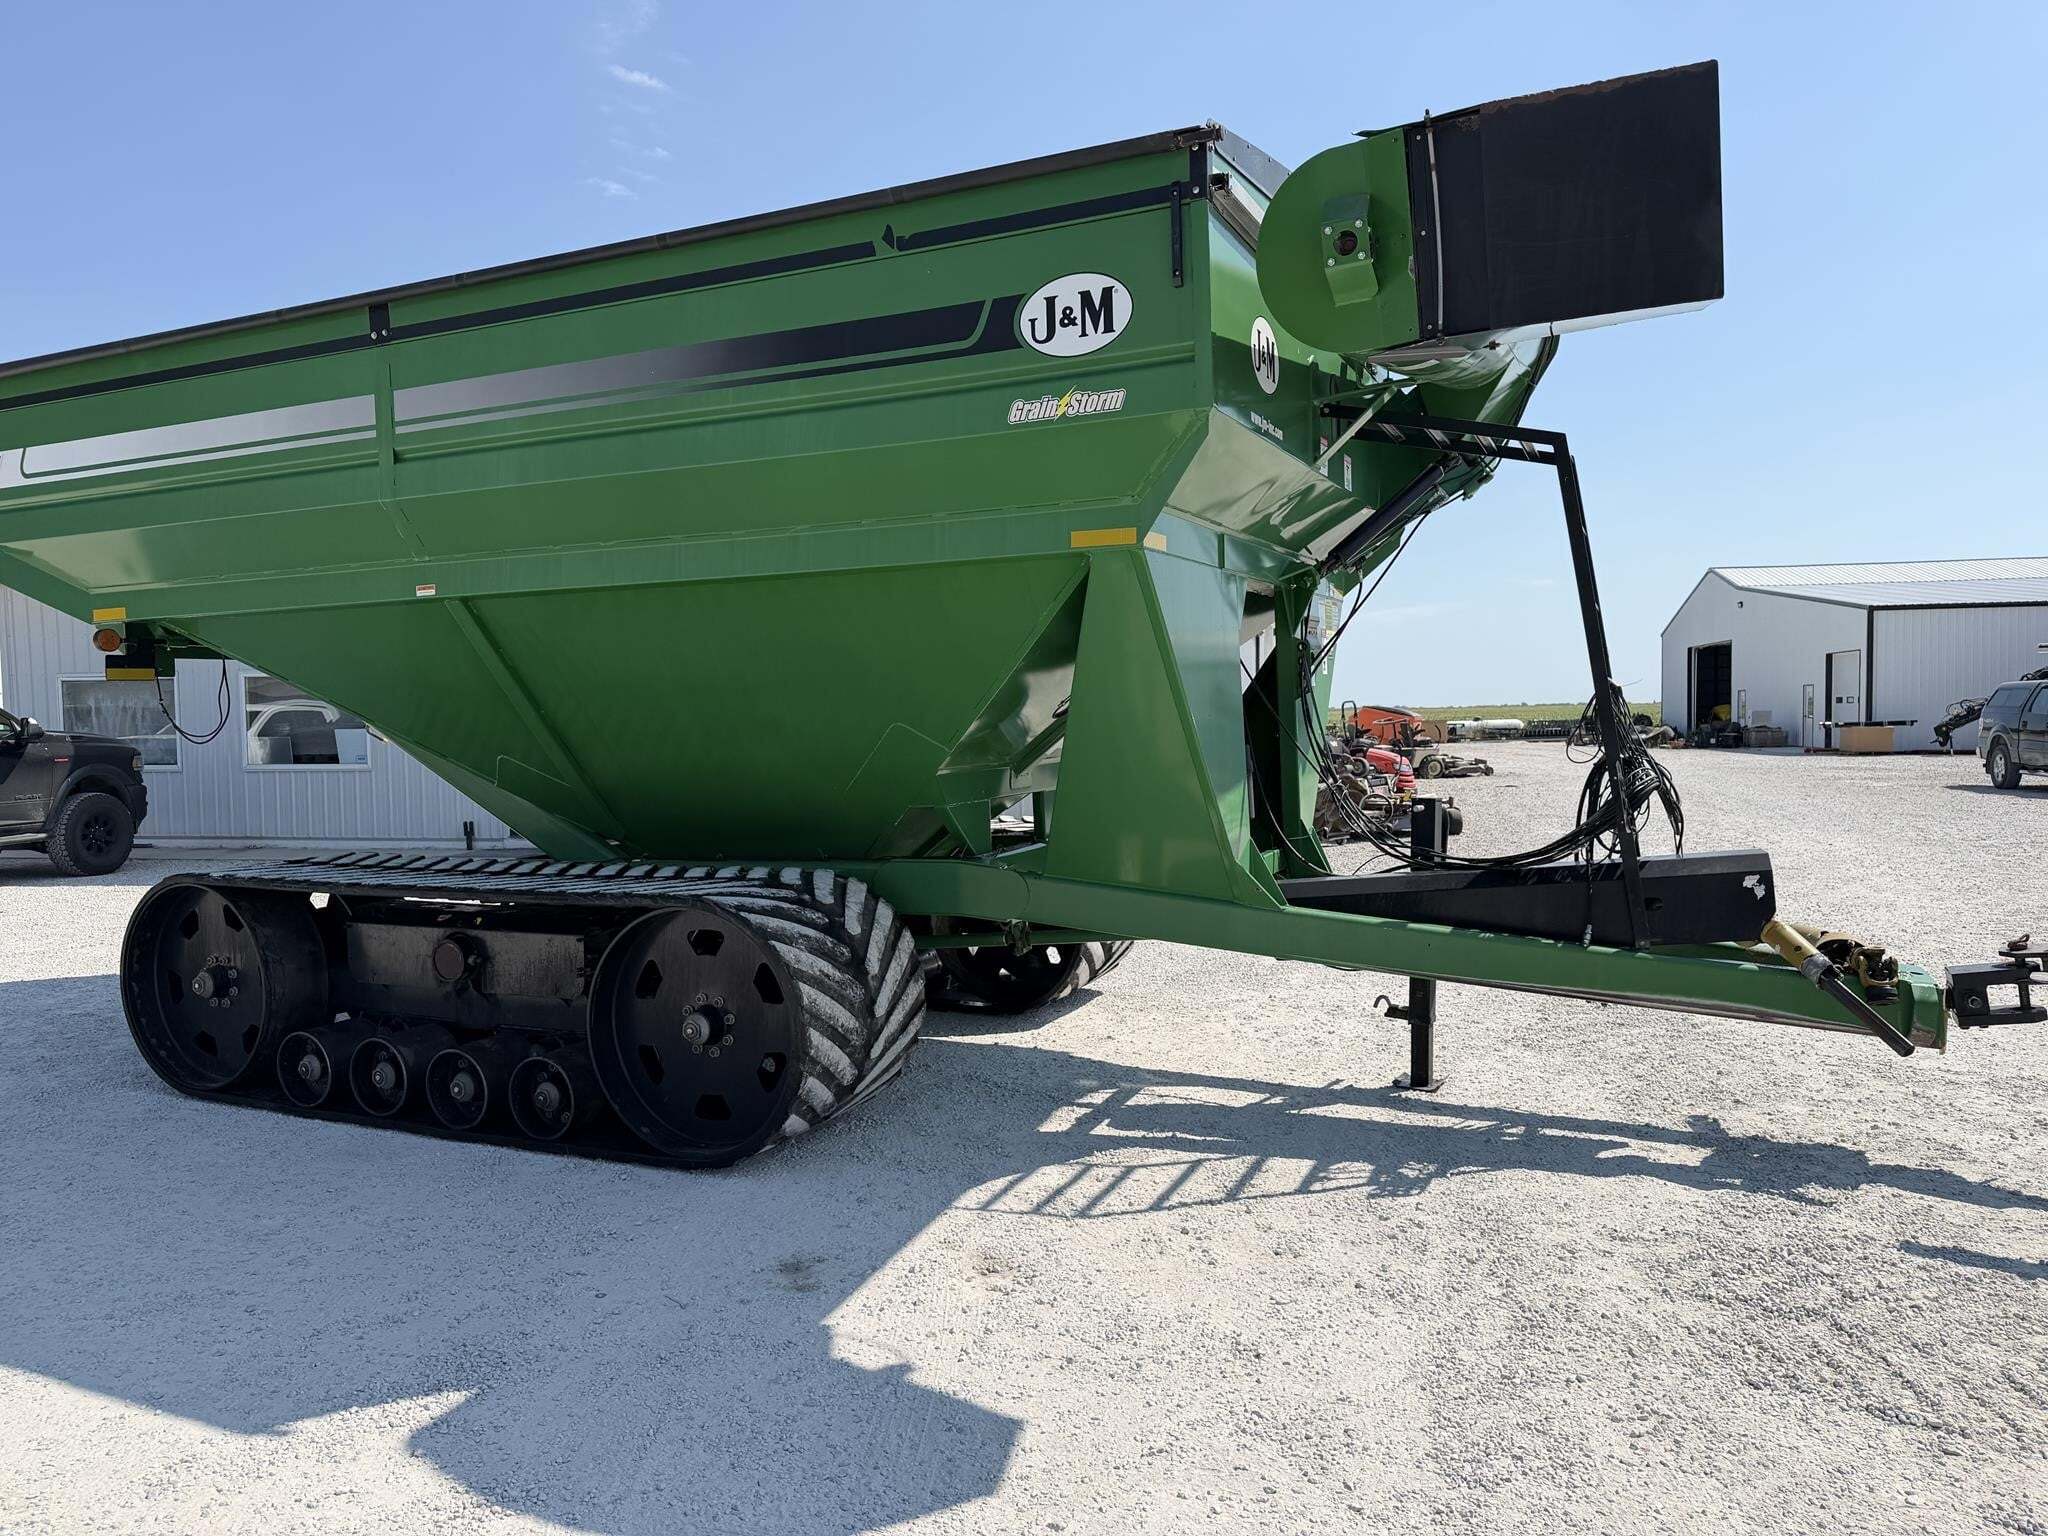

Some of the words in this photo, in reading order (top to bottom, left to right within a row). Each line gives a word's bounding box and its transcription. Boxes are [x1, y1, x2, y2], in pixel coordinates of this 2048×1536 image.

[1028, 285, 1116, 345] J&M
[1253, 328, 1277, 385] J&M
[1008, 395, 1060, 424] Grain
[1066, 388, 1126, 417] Storm
